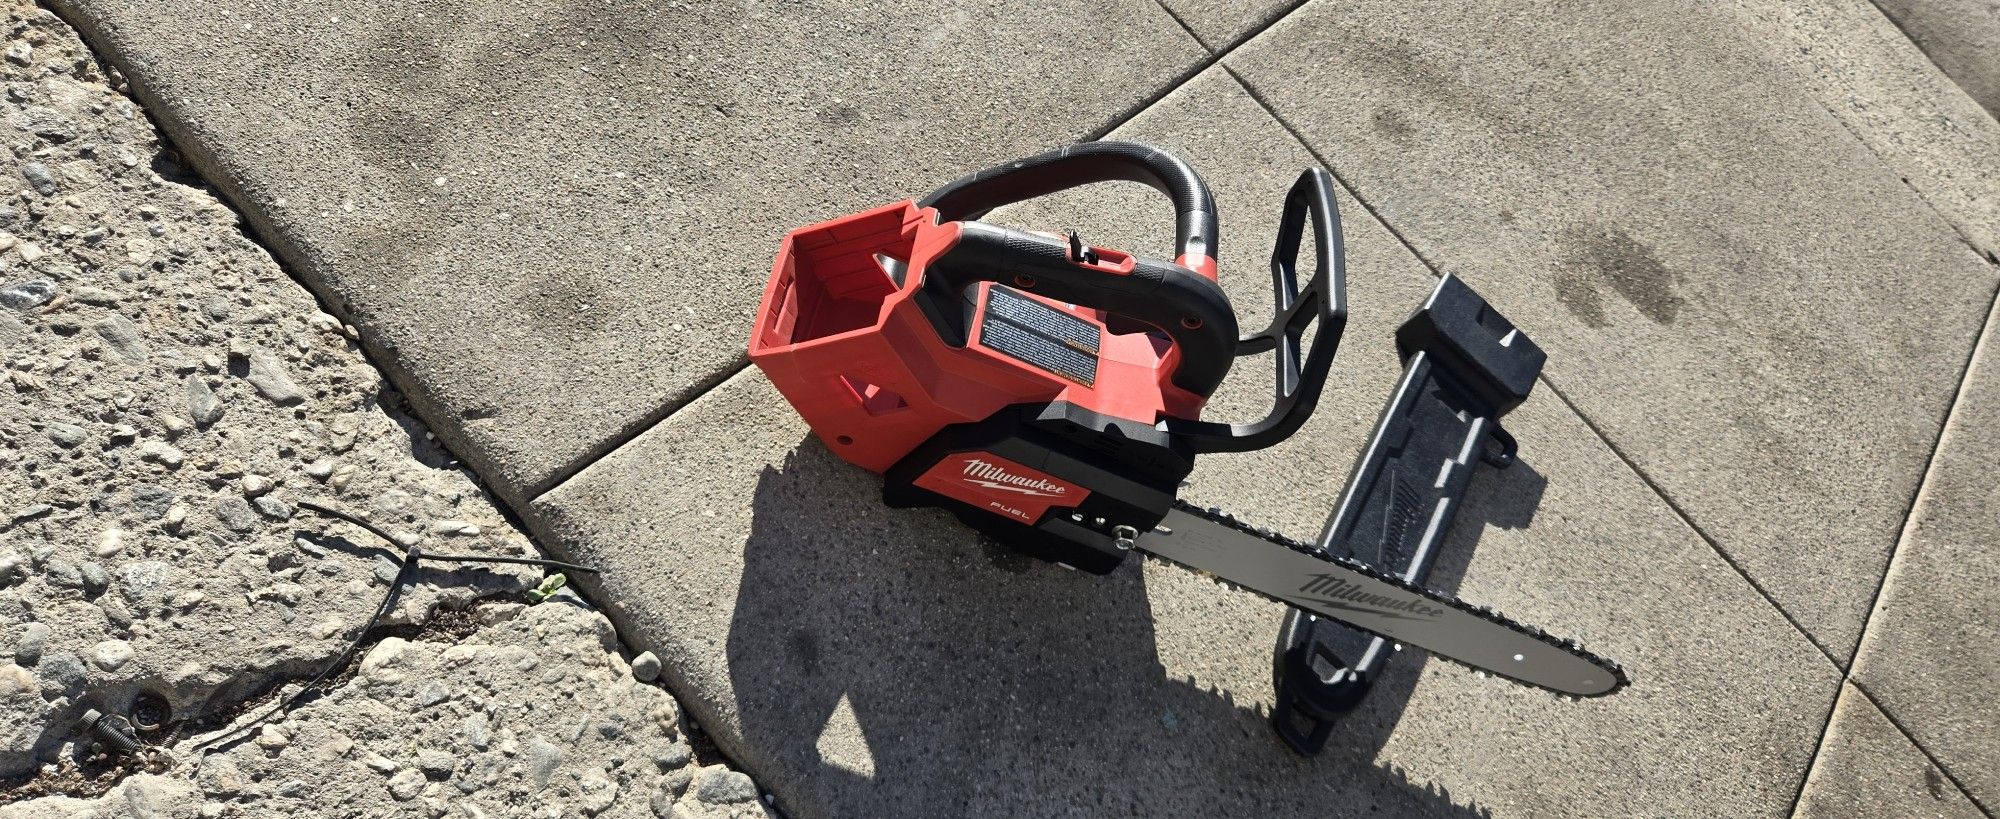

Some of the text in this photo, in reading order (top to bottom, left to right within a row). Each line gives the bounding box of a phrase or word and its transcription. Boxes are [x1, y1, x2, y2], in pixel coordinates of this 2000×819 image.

[963, 459, 1065, 494] Milwaukee
[990, 501, 1030, 520] FUEL
[1299, 573, 1444, 617] Milwaukee
